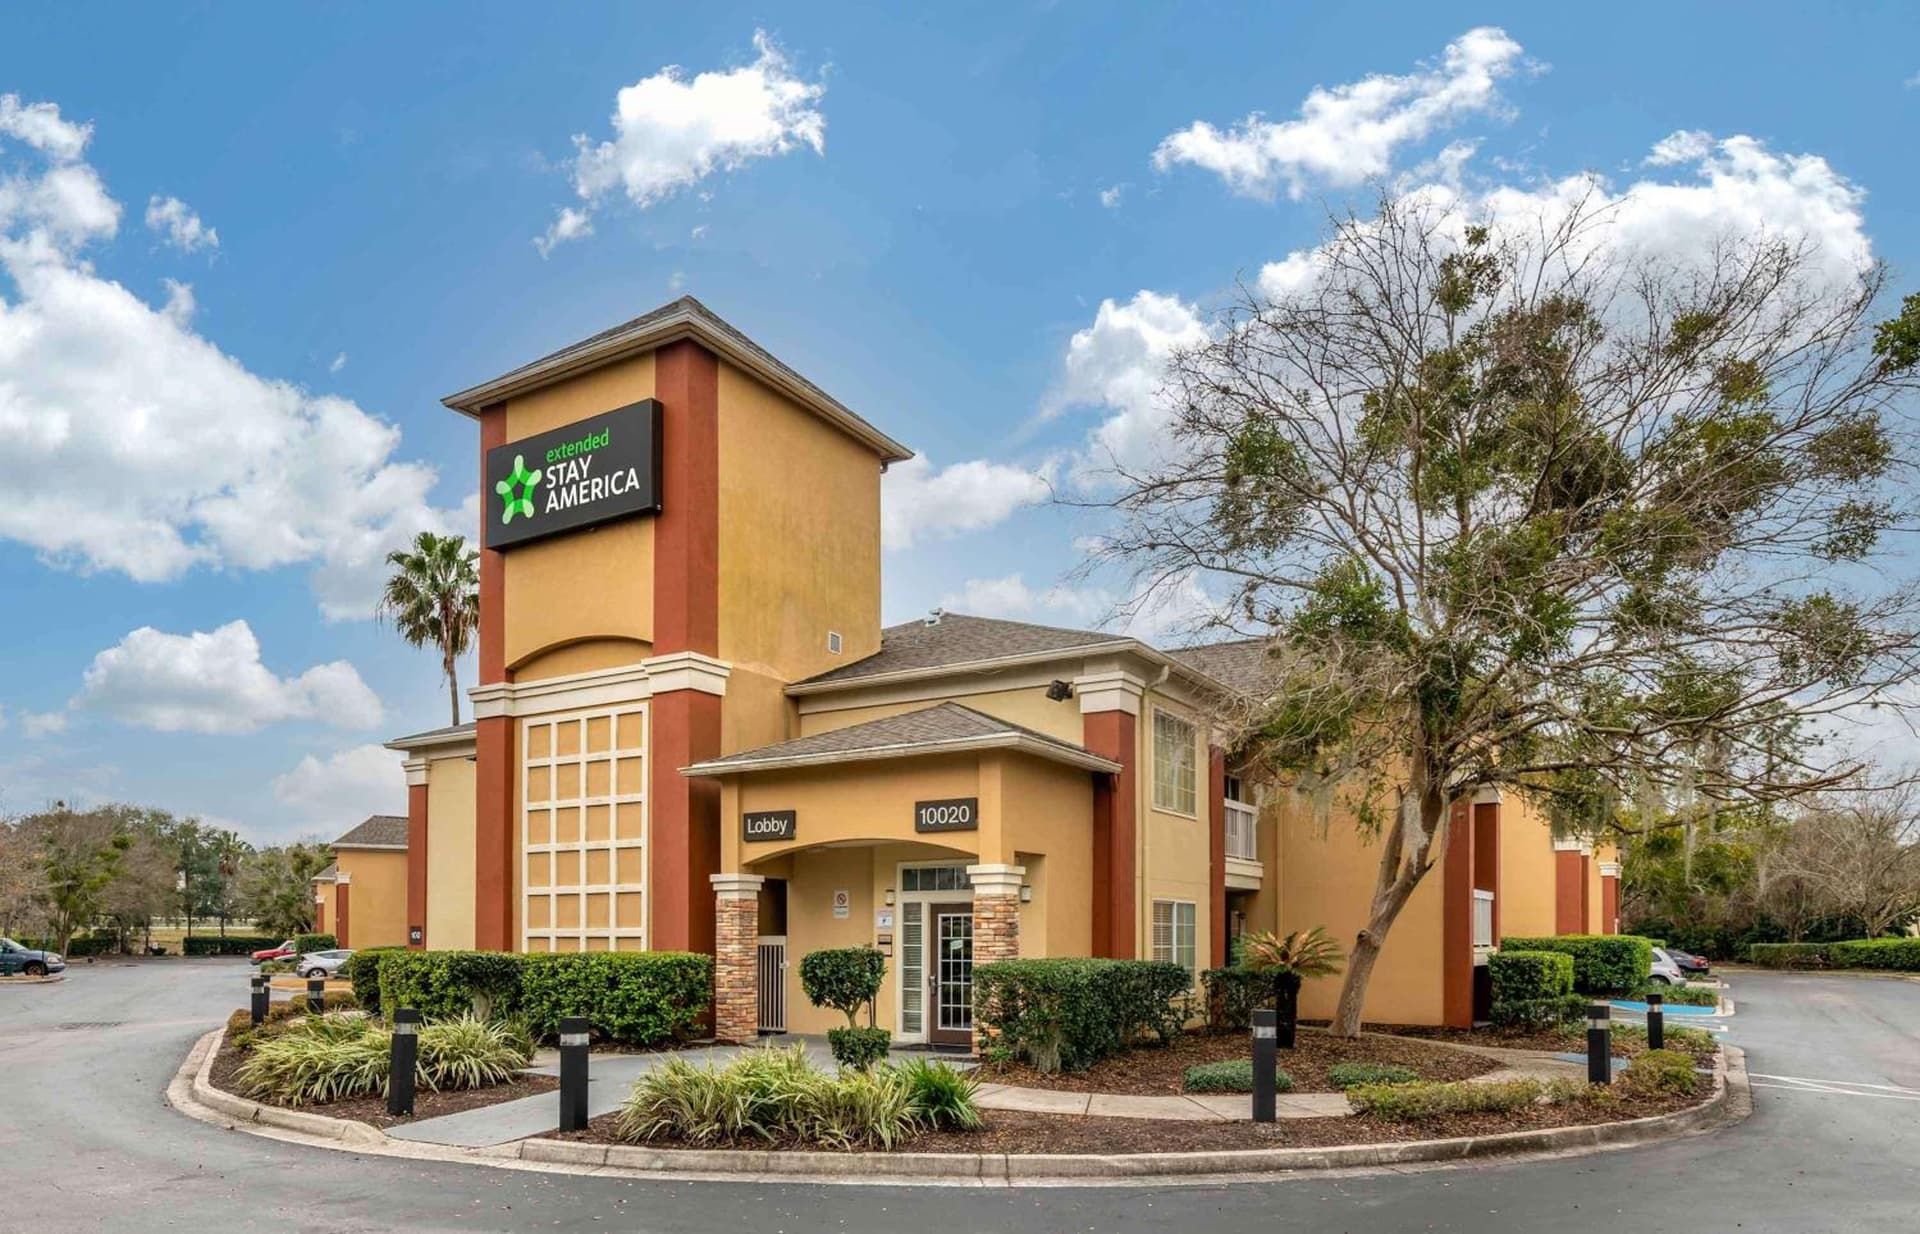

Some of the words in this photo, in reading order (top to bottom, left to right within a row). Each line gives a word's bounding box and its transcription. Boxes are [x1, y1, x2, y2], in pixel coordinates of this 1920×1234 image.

[546, 427, 609, 462] extended
[546, 455, 592, 489] STAY
[545, 467, 640, 514] AMERICA
[747, 816, 788, 835] Lobby
[920, 805, 970, 825] 10020
